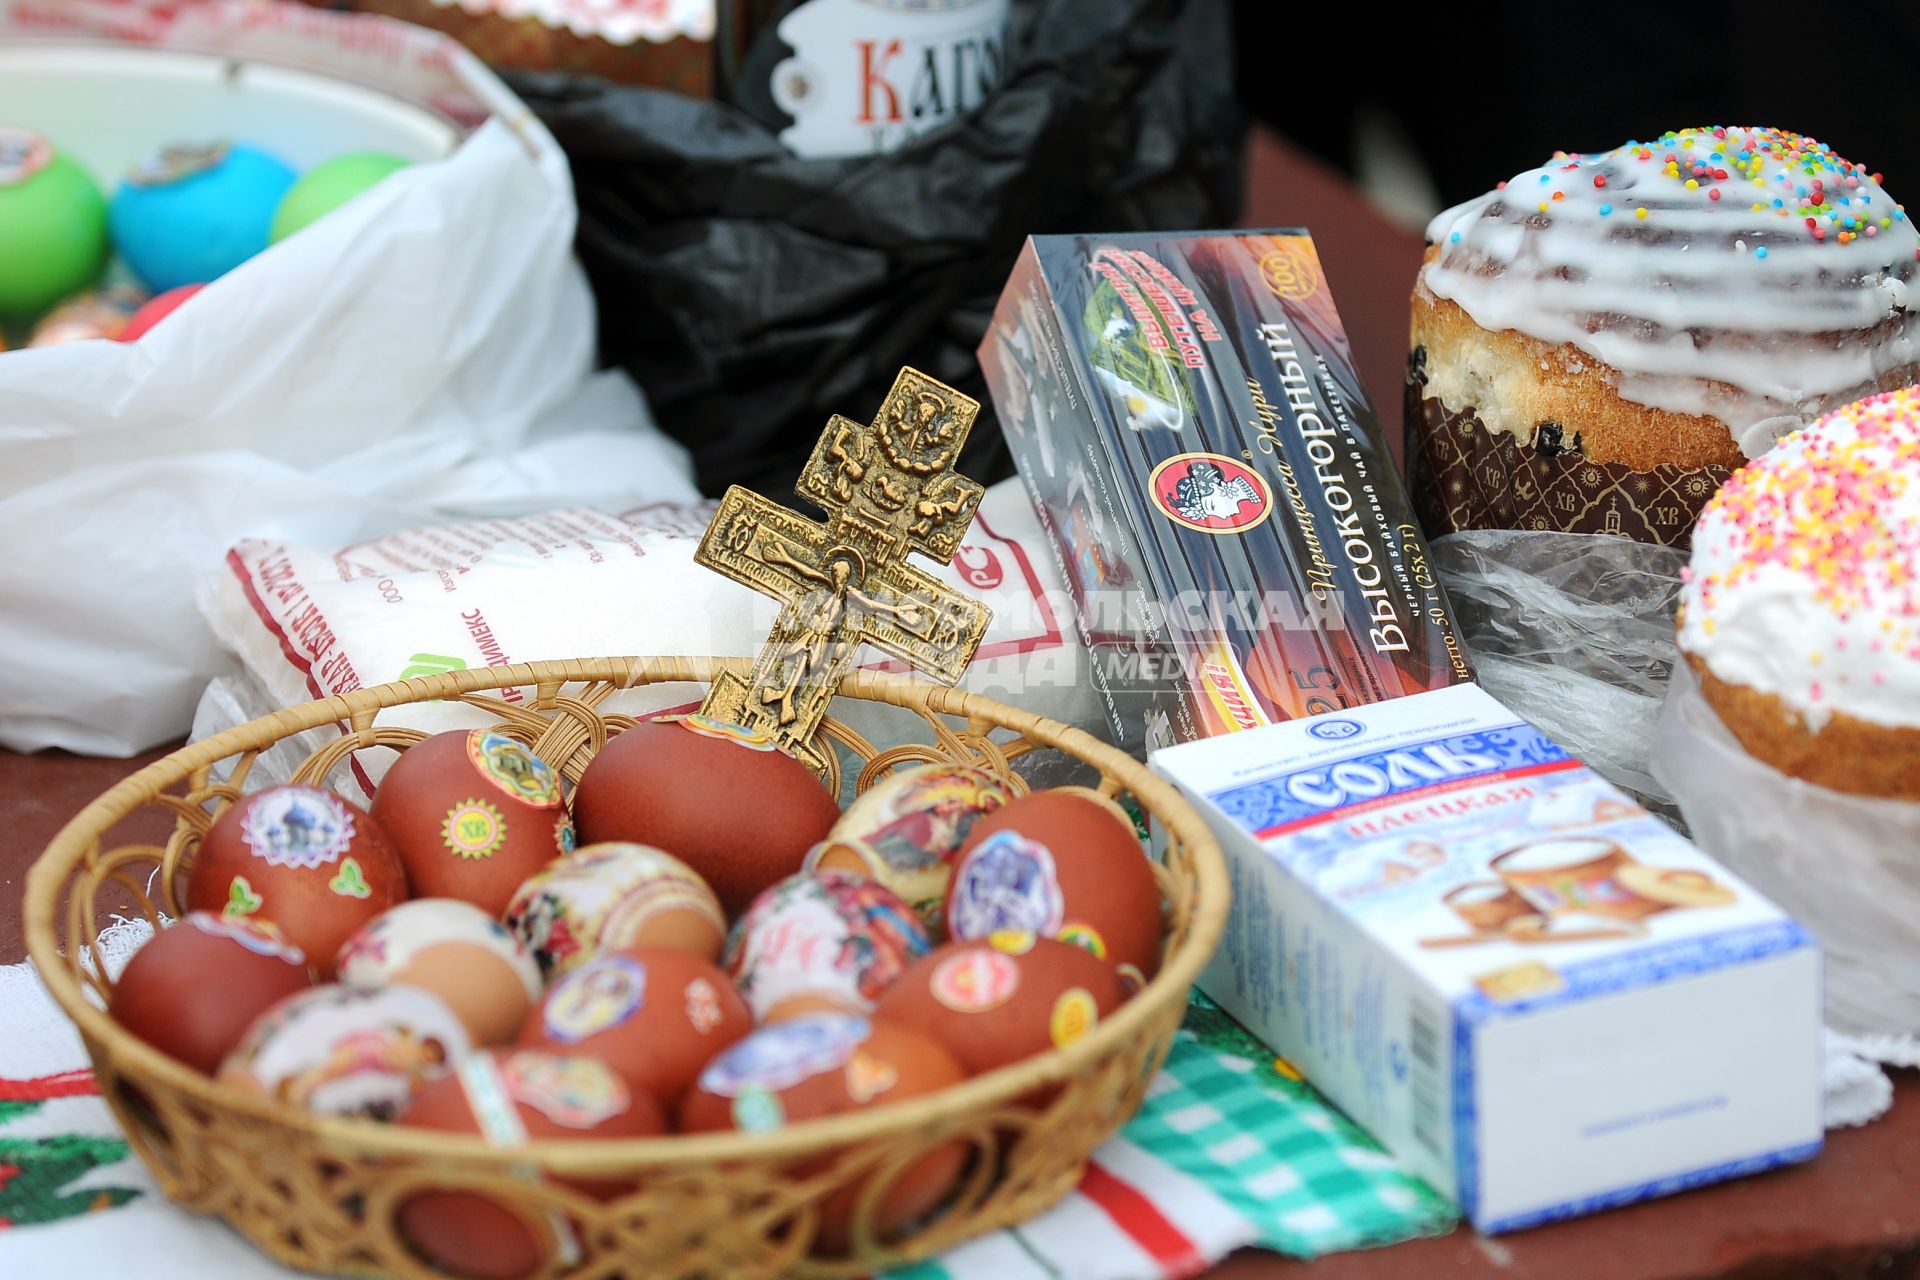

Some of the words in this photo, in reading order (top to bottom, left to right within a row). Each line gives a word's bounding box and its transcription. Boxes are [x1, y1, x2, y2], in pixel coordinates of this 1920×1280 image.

[1189, 308, 1222, 341] НА
[1247, 377, 1284, 455] Нури
[1314, 354, 1351, 431] ПАКЕТИКАХ
[1350, 451, 1368, 478] ЧАЙ
[1277, 460, 1338, 601] Принцесса
[1362, 484, 1400, 557] БАЙХОВЫЙ
[1556, 492, 1576, 512] ХВ
[1655, 506, 1679, 526] ХВ
[1393, 564, 1421, 617] ЧЕРНЫЙ
[1428, 607, 1450, 627] 50
[460, 607, 525, 703] РДИМЕКС
[1203, 662, 1258, 731] КЦИЯ!
[1288, 664, 1349, 716] 25
[1286, 744, 1500, 808] СОЛЬ
